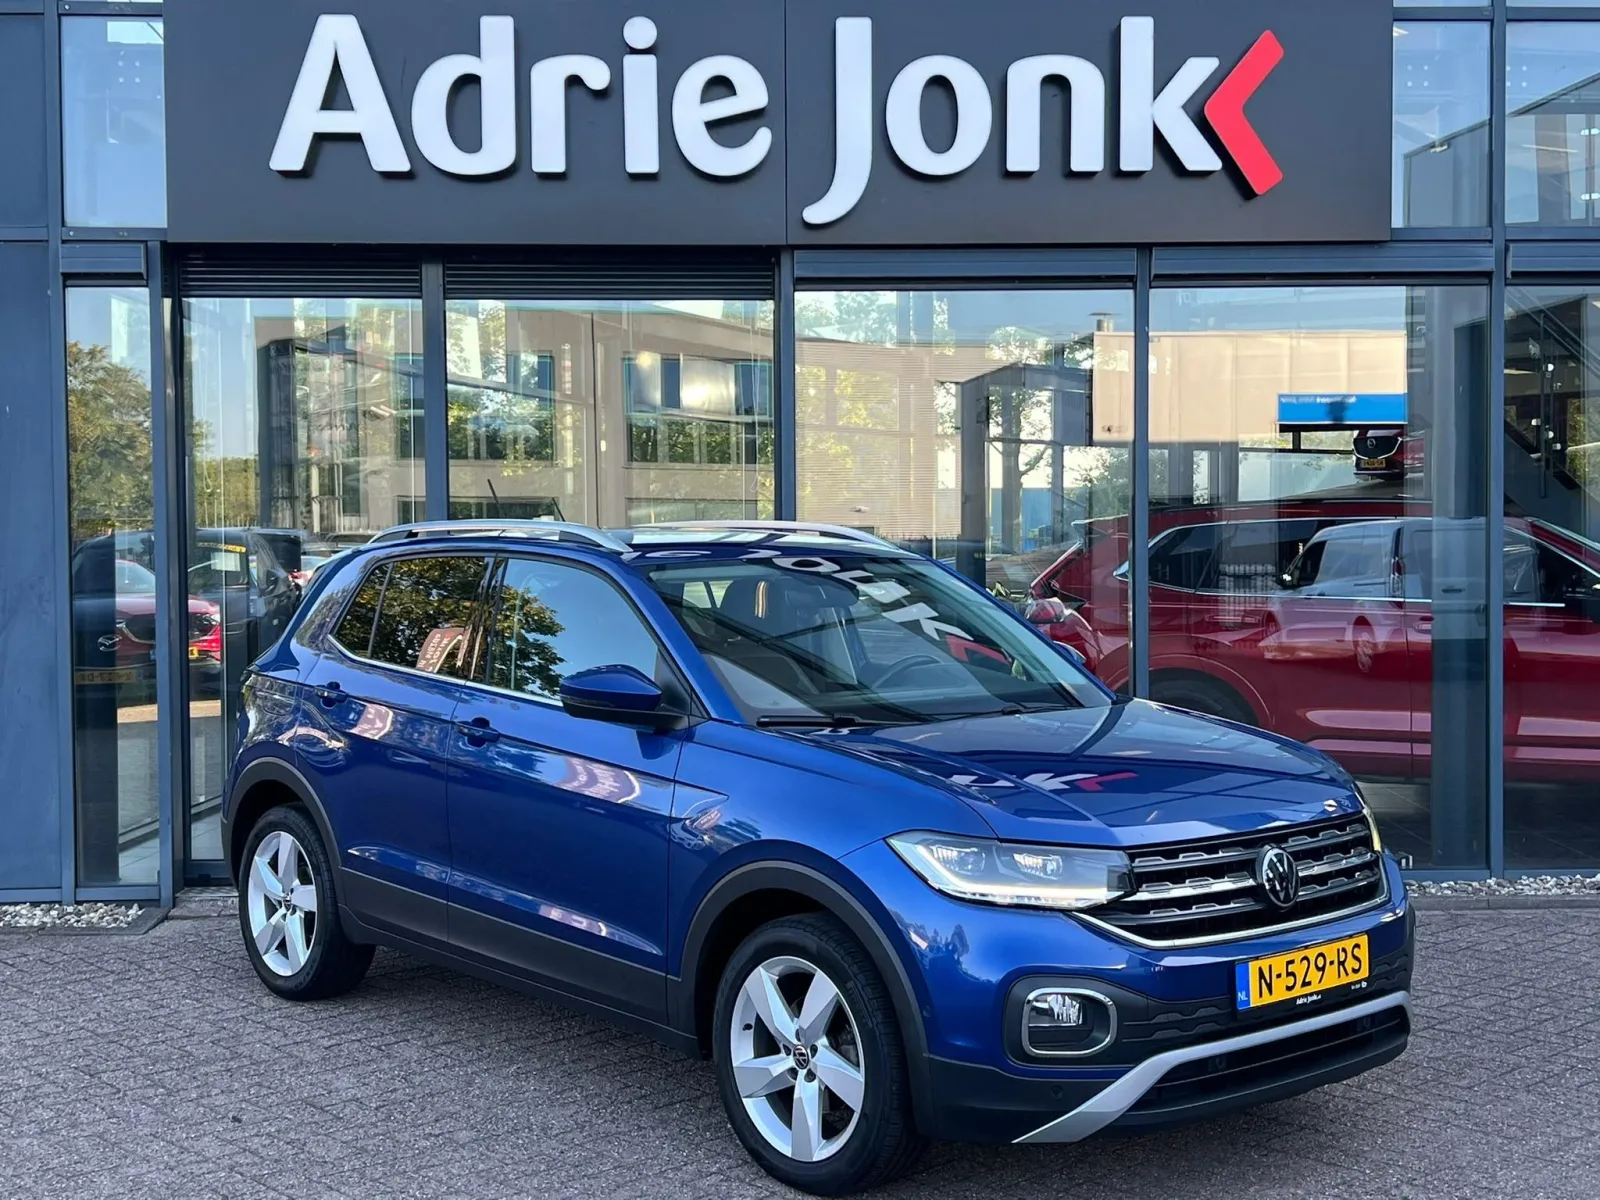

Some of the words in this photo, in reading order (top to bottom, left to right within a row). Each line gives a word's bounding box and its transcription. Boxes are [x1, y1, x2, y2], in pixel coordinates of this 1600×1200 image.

[269, 14, 773, 177] Adrie
[802, 16, 1223, 225] Jonk
[1237, 989, 1249, 1002] NL
[1257, 942, 1363, 999] N-529-RS
